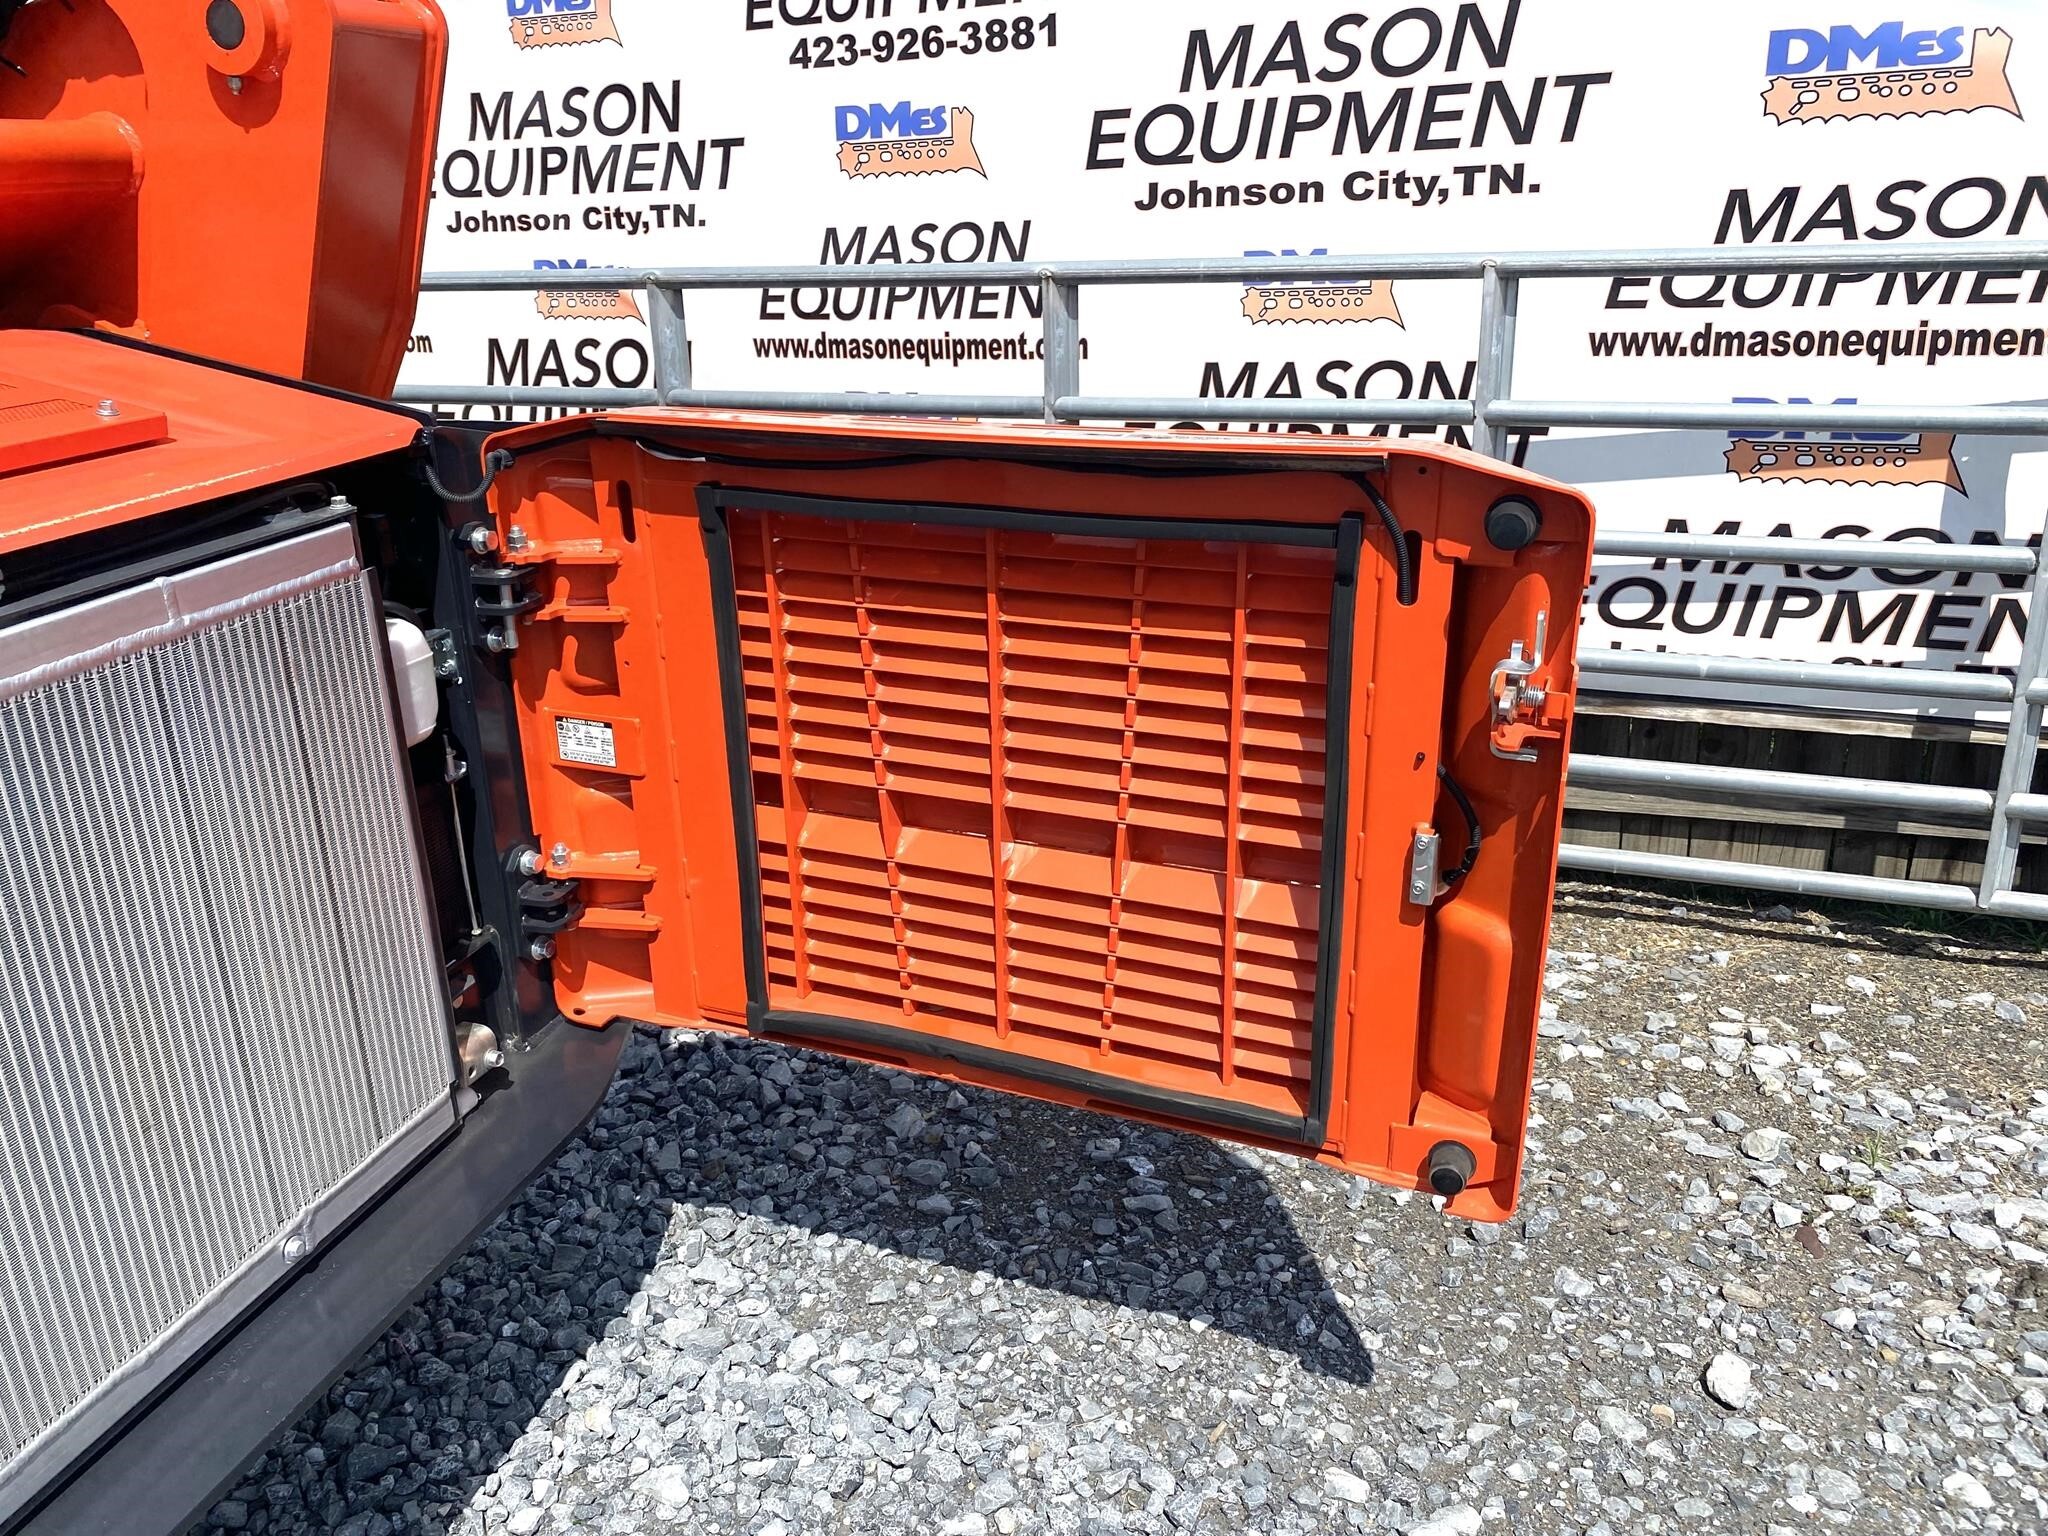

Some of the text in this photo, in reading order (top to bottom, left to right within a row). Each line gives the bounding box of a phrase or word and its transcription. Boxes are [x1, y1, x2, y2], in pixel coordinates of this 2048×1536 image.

[789, 13, 1057, 69] 423-926-3881
[1179, 0, 1521, 93] MASON
[468, 80, 681, 142] MASON
[1085, 71, 1614, 171] EQUIPMENT
[431, 137, 745, 199] QUIPMENT
[1134, 163, 1541, 212] Johnson City,TN.
[446, 204, 707, 236] Johnson City,TN.
[1714, 176, 2048, 245] MASON
[820, 220, 1032, 265] MASON
[760, 285, 1043, 320] EQUIPMEN
[1604, 270, 2048, 310] EQUIPME
[486, 338, 692, 389] MASO
[753, 330, 1089, 367] www.dmasonequipment.c
[1200, 360, 1477, 399] MASON
[1578, 574, 2029, 655] QUIPMEN
